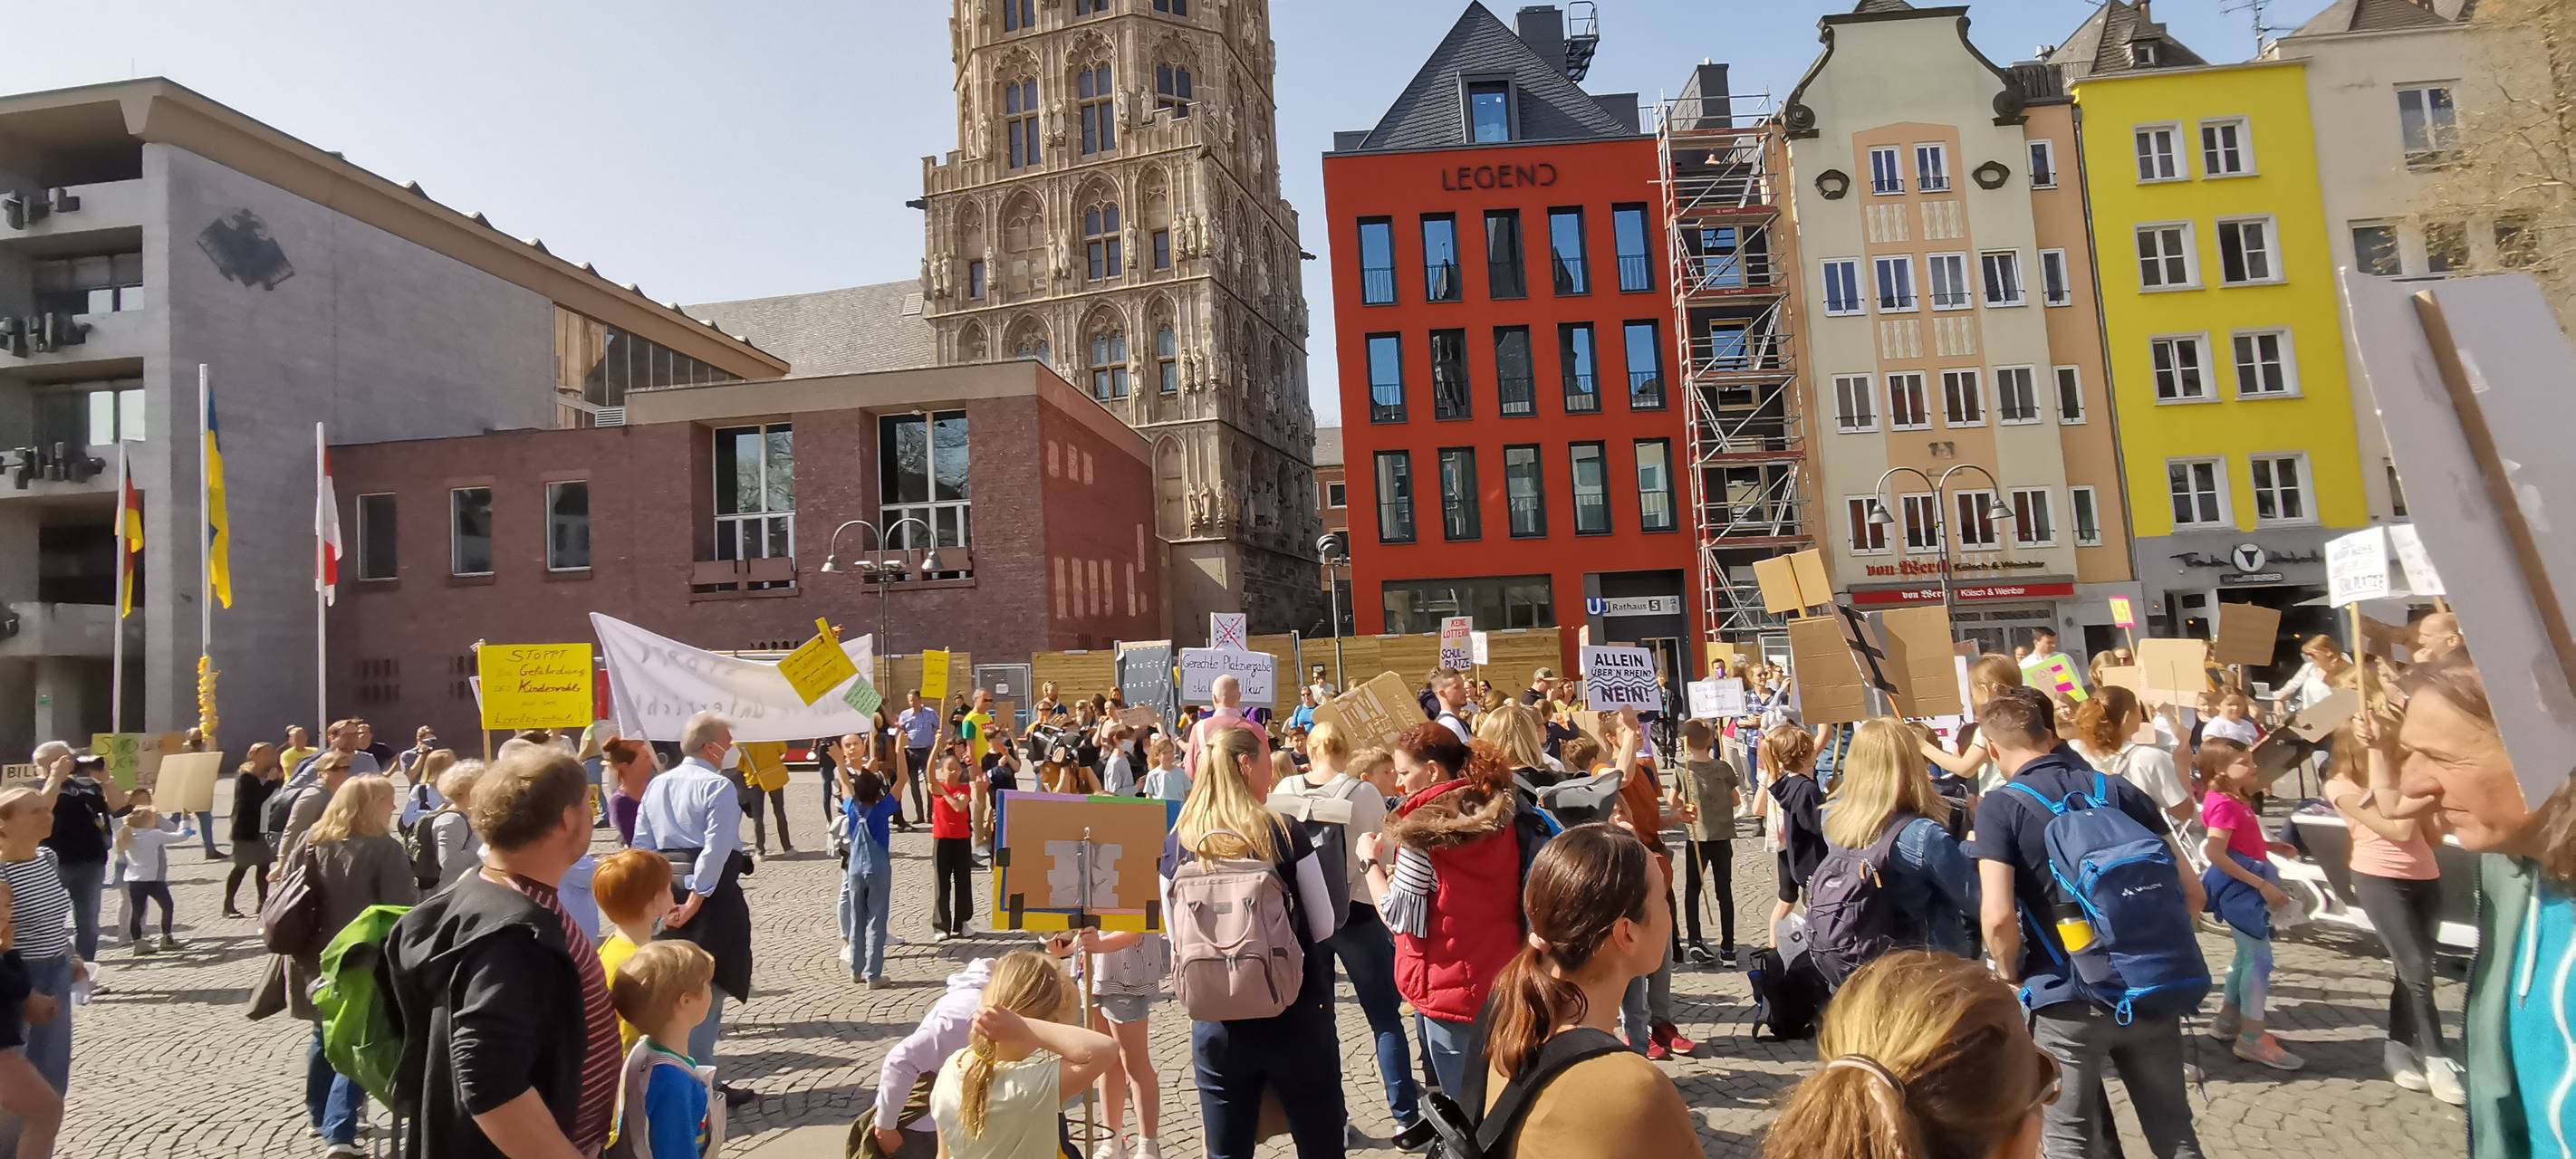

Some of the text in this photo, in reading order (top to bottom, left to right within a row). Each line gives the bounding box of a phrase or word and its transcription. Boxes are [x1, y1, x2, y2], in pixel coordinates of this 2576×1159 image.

[1442, 163, 1557, 191] LEGEND
[1866, 565, 1895, 576] von
[1992, 561, 2000, 570] &
[1920, 589, 1946, 599] Wer
[1995, 587, 2025, 595] Weinbar
[1587, 598, 1601, 615] U
[1612, 602, 1648, 611] Rathaus
[506, 649, 568, 662] STOPPT
[1441, 648, 1466, 660] SCHUL-
[1594, 653, 1645, 667] ALLEIN
[1182, 655, 1272, 678] Gerechte Platzvergabe
[1624, 669, 1652, 677] RHEIN?
[1601, 685, 1650, 703] NEIN!
